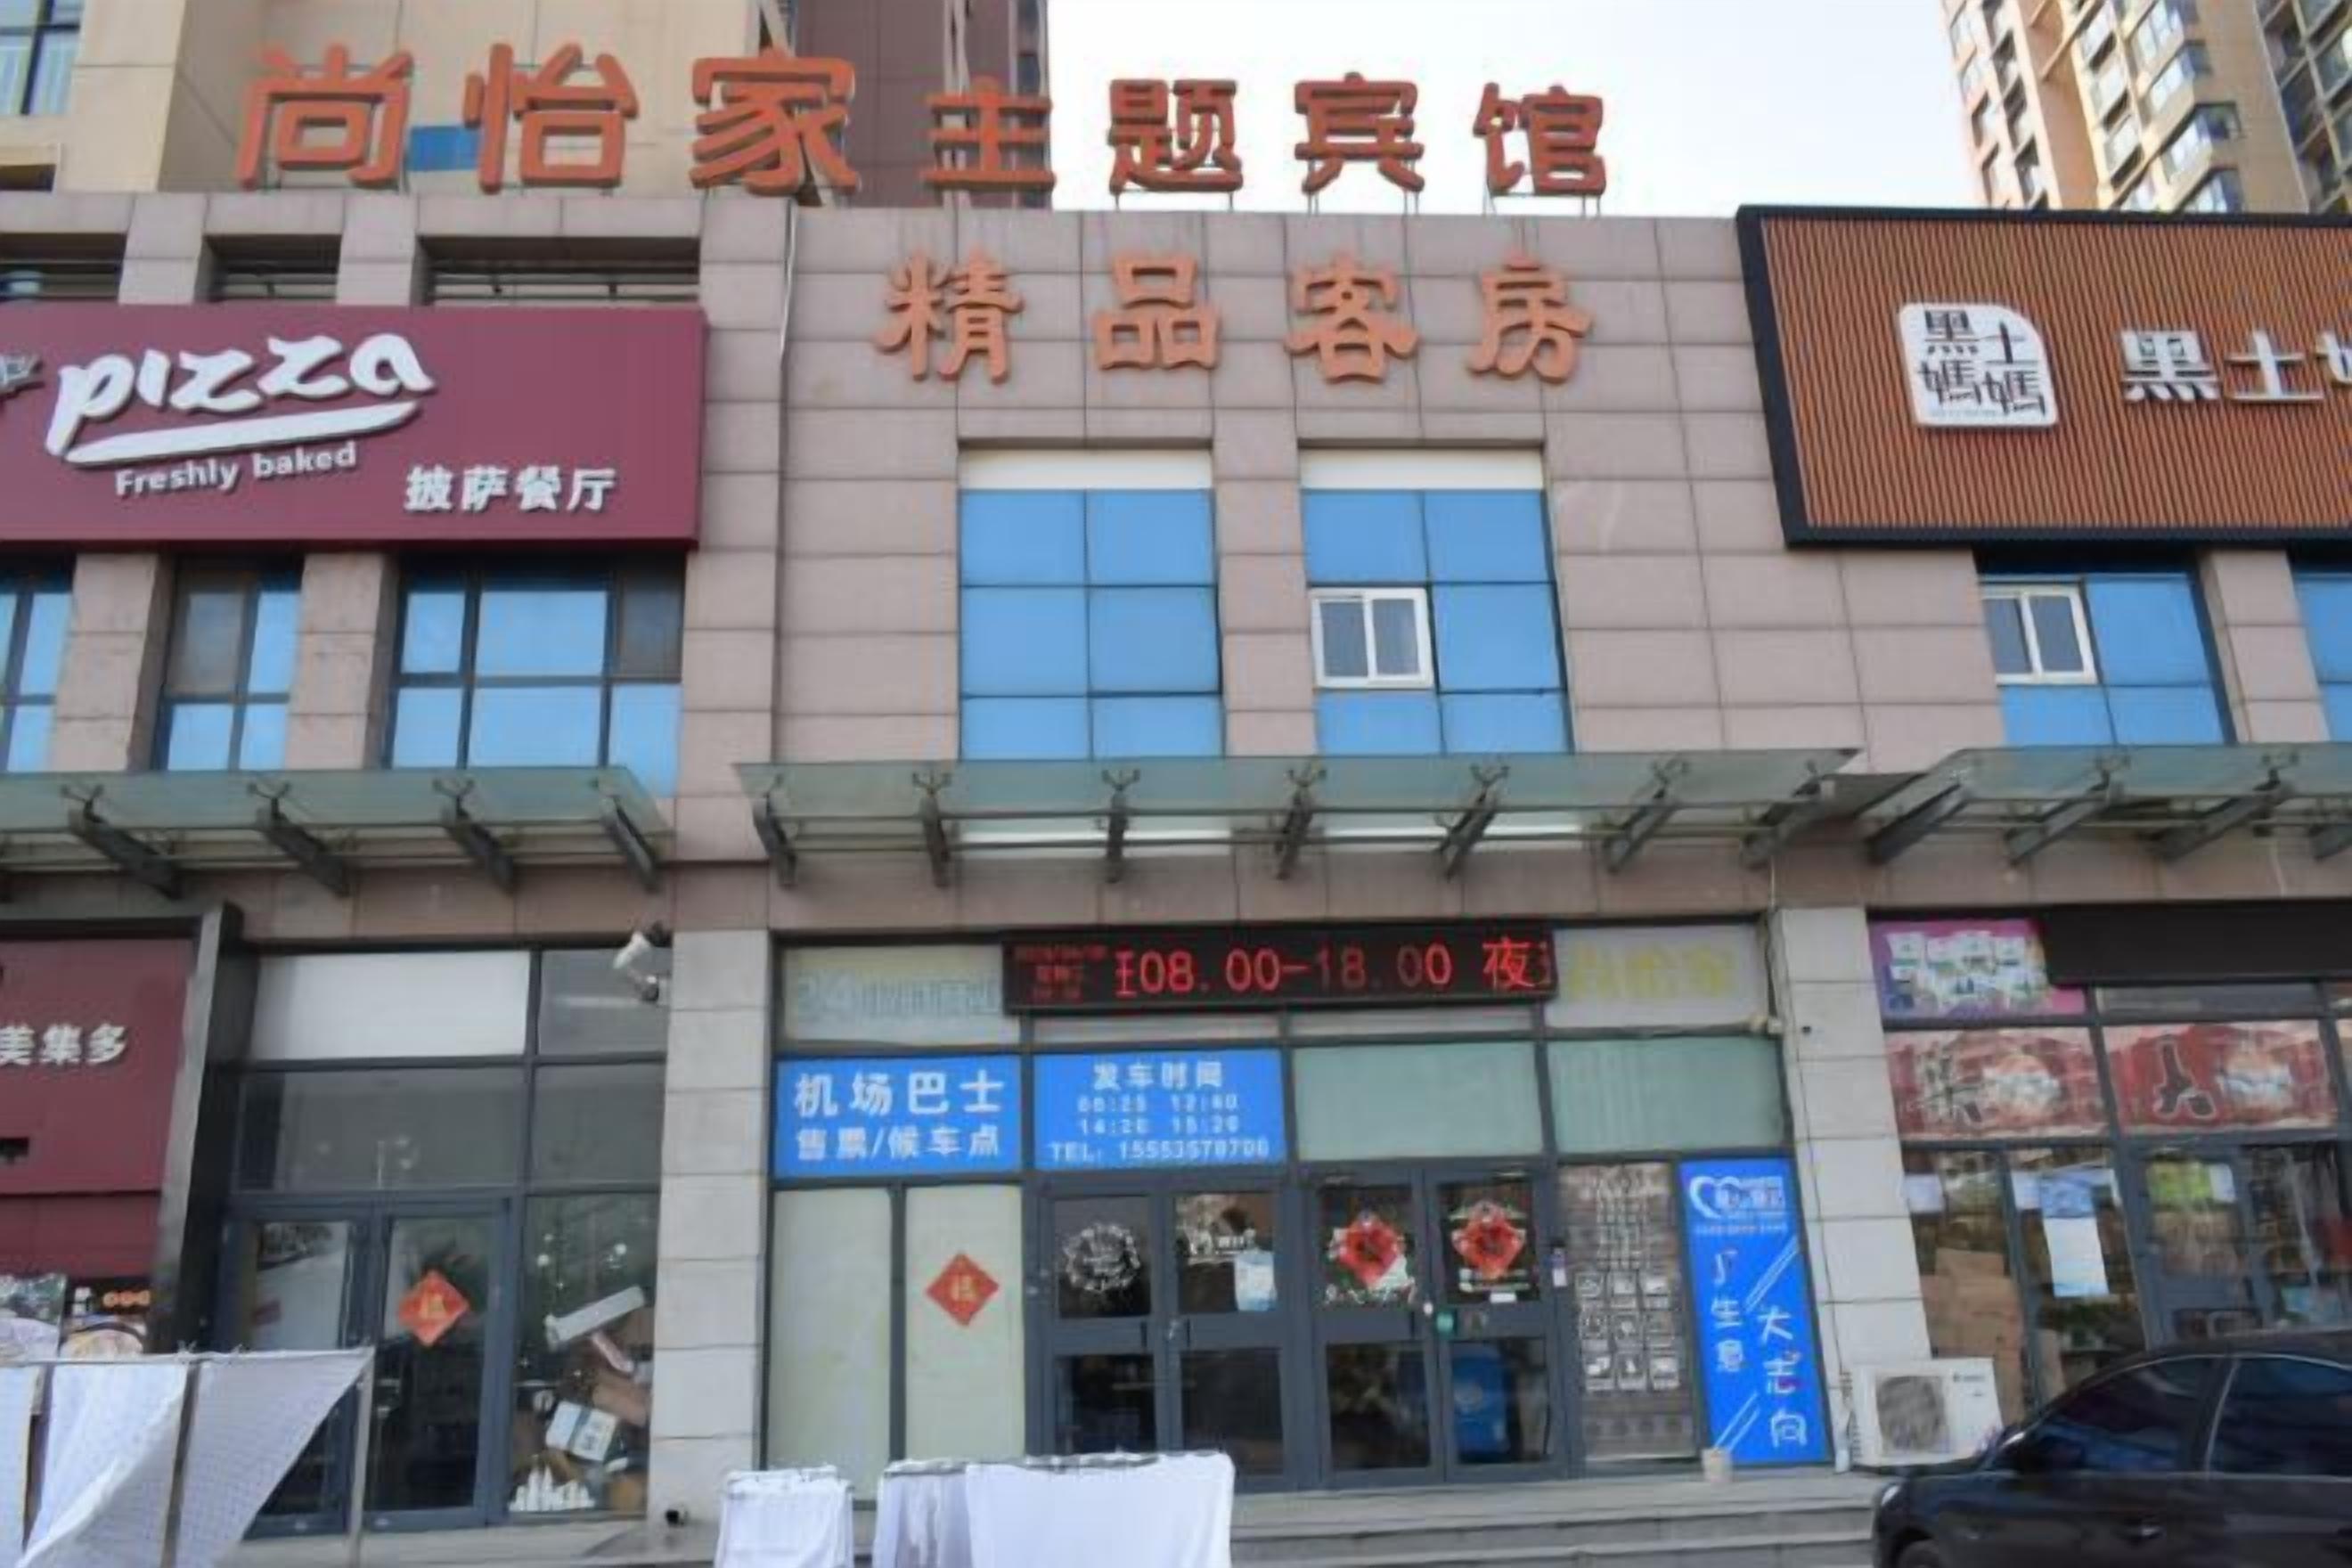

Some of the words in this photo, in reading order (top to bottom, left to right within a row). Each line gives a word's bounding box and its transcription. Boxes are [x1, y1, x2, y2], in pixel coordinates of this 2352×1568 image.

[235, 43, 1606, 196] 尚怡家主题宾馆
[876, 248, 1593, 384] 精品客房
[45, 333, 435, 456] pizza
[116, 459, 238, 496] Freshly
[252, 442, 356, 479] baked
[404, 464, 616, 513] 披萨餐厅
[1482, 936, 1550, 988] 夜
[0, 1024, 126, 1065] 美集多
[795, 1069, 1004, 1117] 机场巴士
[1093, 1061, 1223, 1091] 发车时间
